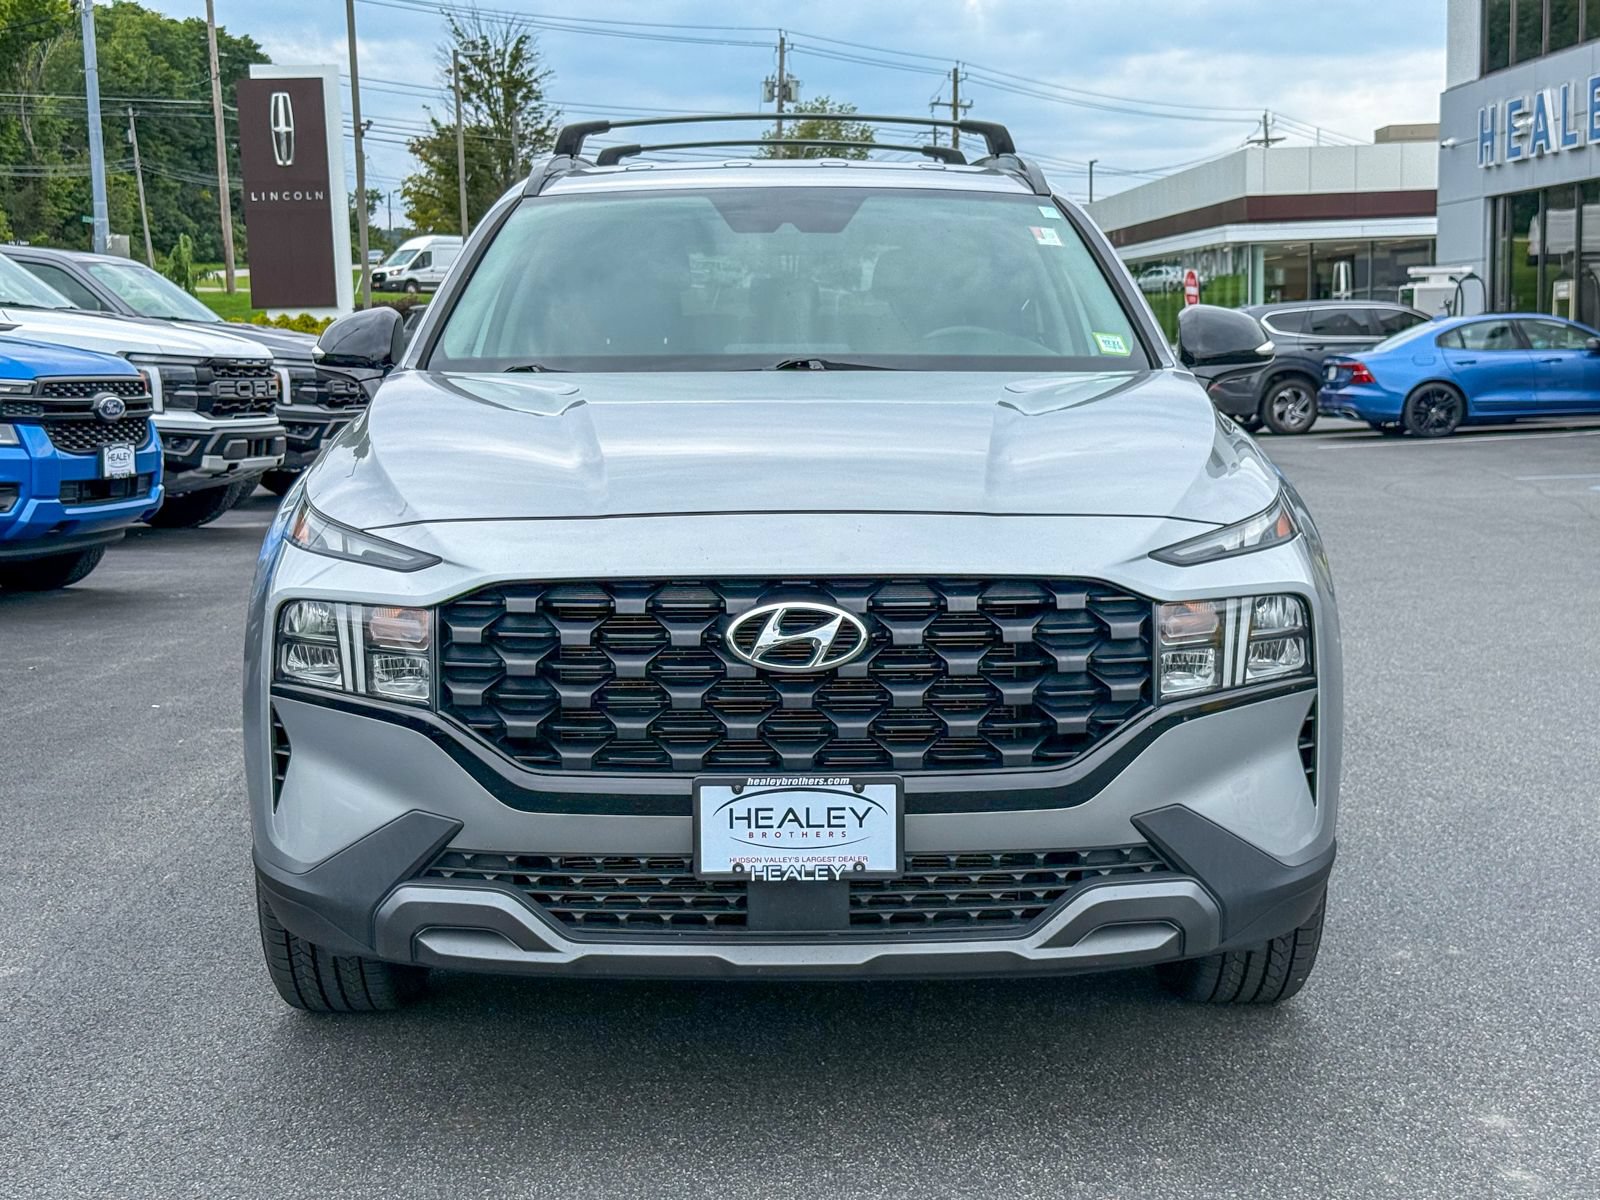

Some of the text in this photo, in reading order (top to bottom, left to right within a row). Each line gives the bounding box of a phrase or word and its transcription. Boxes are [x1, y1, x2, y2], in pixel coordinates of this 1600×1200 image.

[251, 191, 324, 201] LINCOLN
[213, 381, 278, 398] FORD
[107, 453, 130, 462] HEALEY
[746, 777, 850, 787] healeybrothers.com
[729, 807, 873, 829] HEALEY
[751, 865, 846, 881] HEALEY
